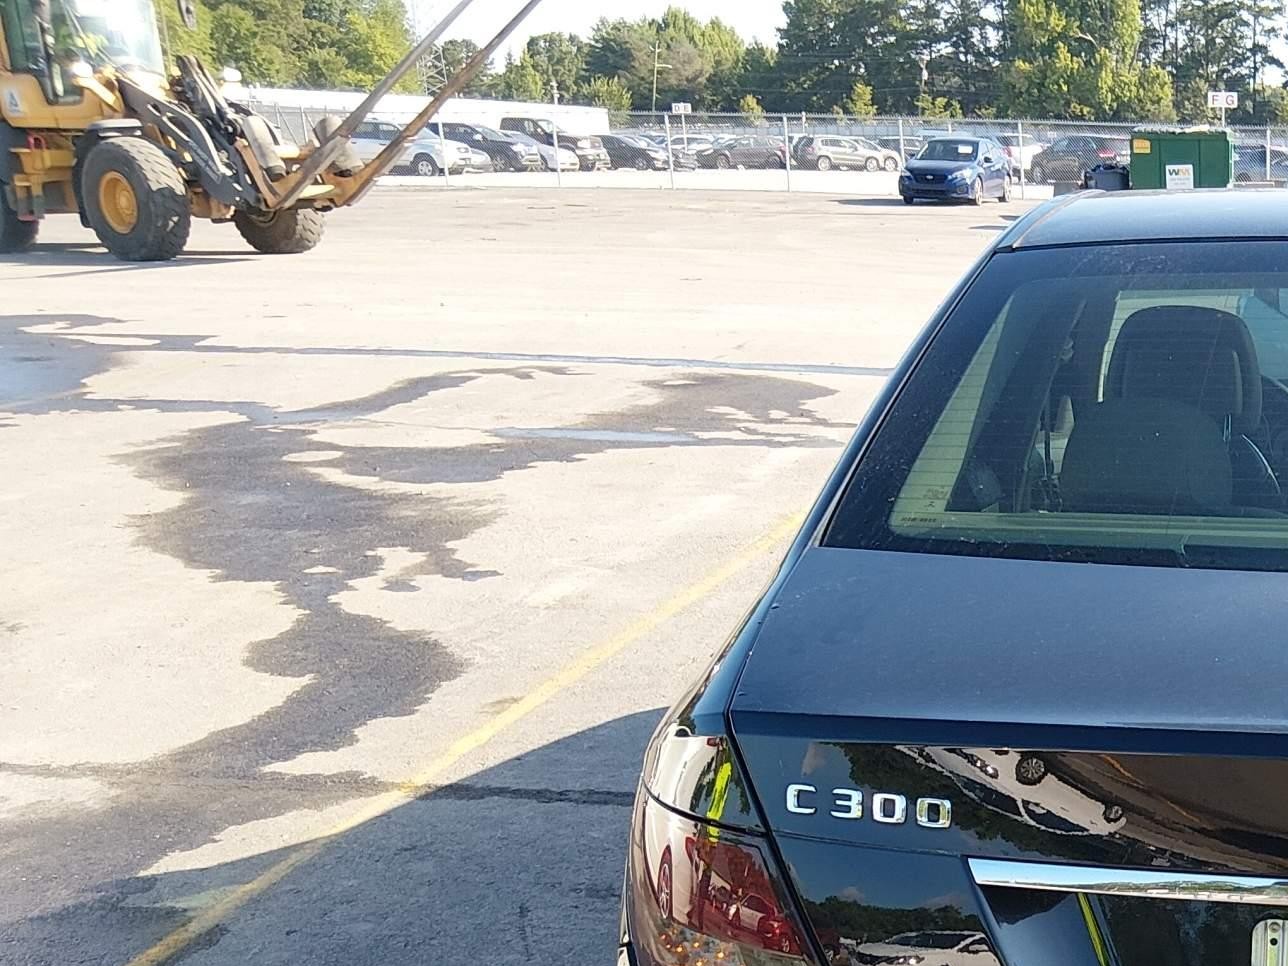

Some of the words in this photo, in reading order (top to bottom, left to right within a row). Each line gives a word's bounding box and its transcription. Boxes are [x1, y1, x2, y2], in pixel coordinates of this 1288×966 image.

[1212, 95, 1220, 105] F
[1226, 95, 1235, 105] G
[786, 783, 816, 814] C
[830, 787, 952, 829] 300
